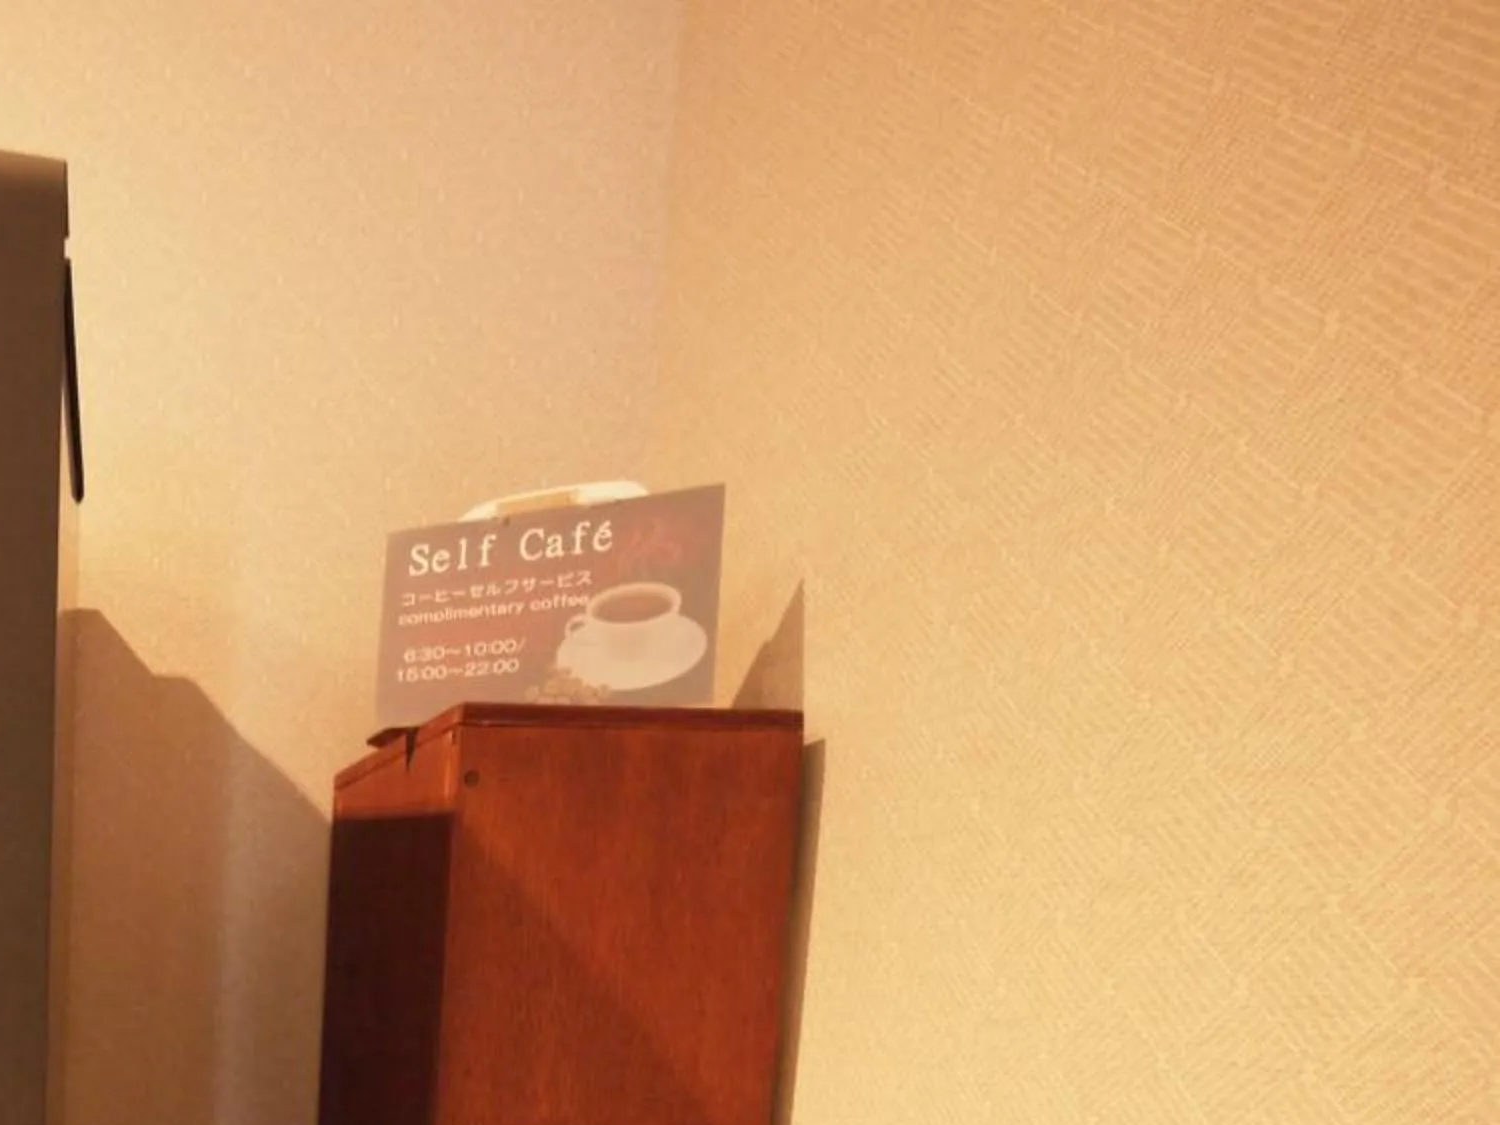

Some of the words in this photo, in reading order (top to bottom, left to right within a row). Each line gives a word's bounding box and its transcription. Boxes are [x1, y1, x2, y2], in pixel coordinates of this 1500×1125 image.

[408, 534, 496, 576] Self
[519, 520, 613, 561] Café
[401, 570, 593, 607] コーヒーセルフサービス
[398, 601, 525, 626] complimentary
